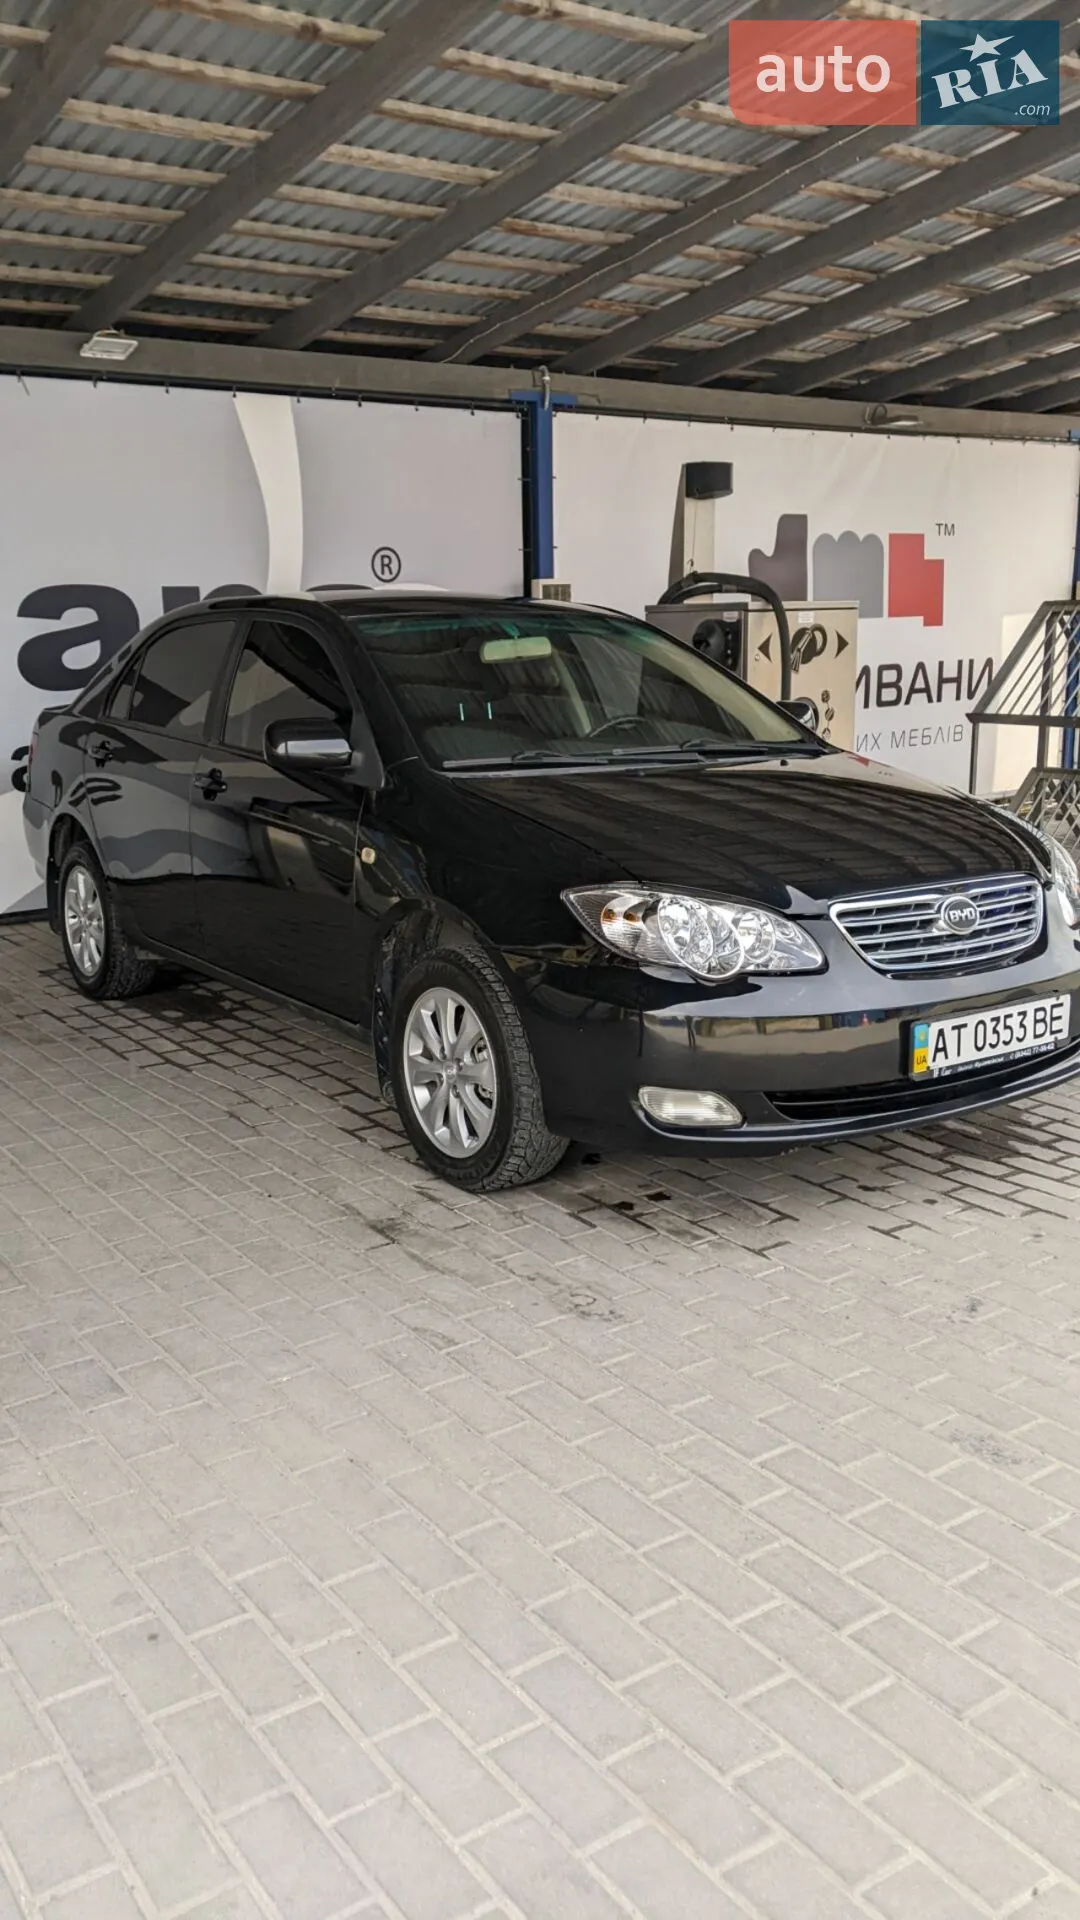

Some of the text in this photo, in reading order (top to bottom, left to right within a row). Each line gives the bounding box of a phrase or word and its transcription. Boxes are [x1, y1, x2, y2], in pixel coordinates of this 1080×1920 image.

[935, 523, 955, 537] TM
[890, 724, 964, 749] МЕБЛІВ
[949, 908, 976, 922] BYD
[932, 1002, 1064, 1062] AT 0353 BE
[916, 1055, 927, 1065] UA
